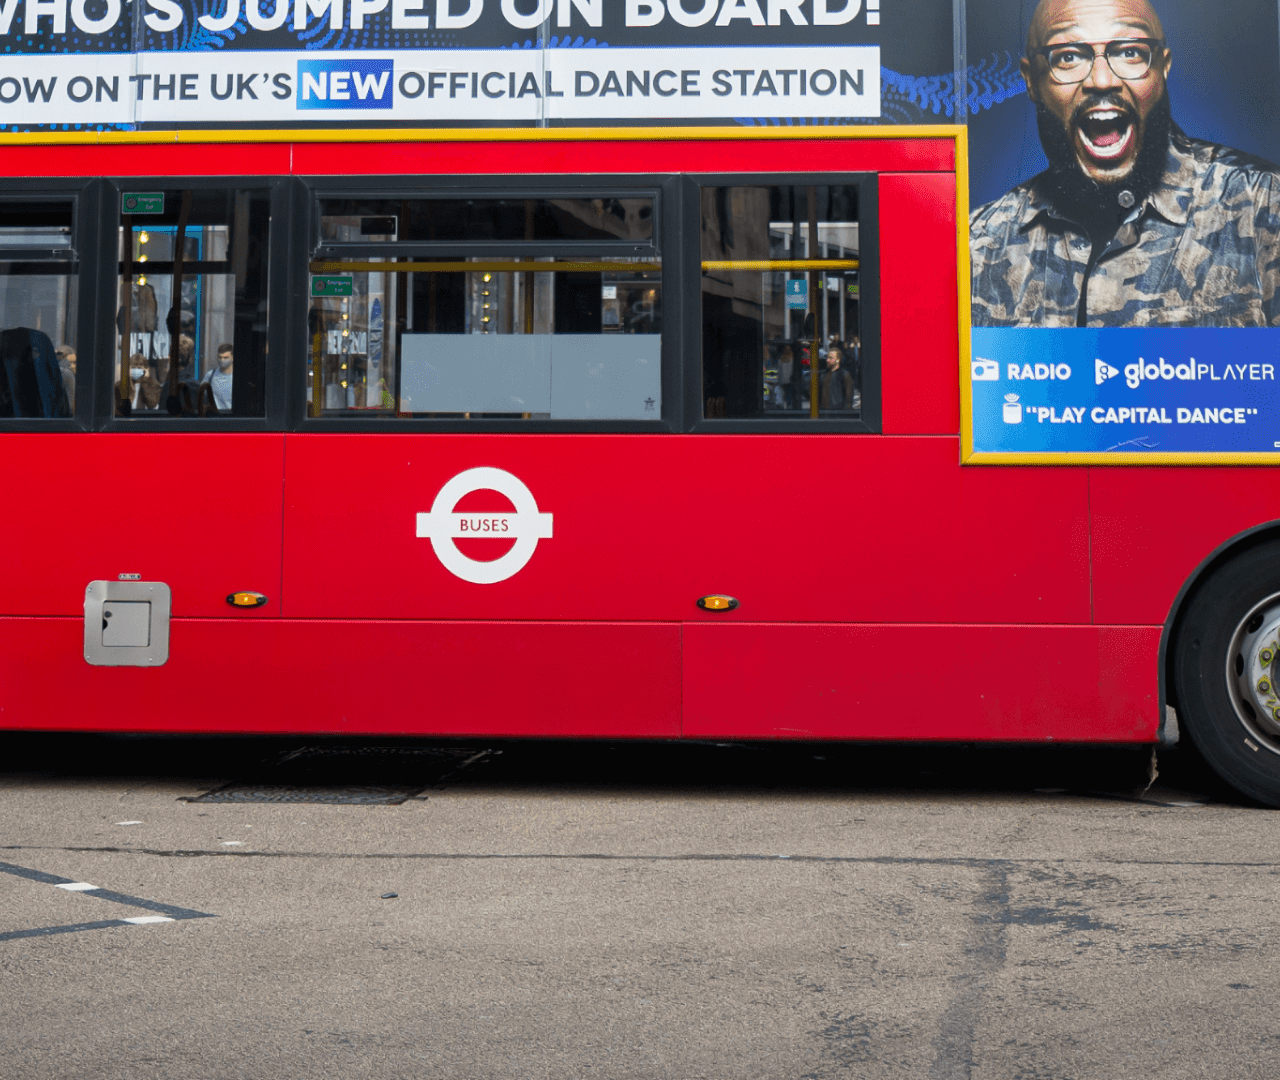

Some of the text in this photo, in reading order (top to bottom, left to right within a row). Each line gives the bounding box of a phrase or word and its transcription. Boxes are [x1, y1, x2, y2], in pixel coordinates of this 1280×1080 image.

[66, 75, 119, 103] ON
[136, 73, 199, 102] THE
[209, 72, 292, 101] UK'S
[301, 71, 389, 101] NEW
[398, 69, 563, 100] OFFICIAL
[574, 69, 701, 98] DANCE
[711, 67, 865, 98] STATION
[1007, 363, 1071, 381] RADIO
[1026, 406, 1258, 424] "PLAY CAPITAL DANCE"
[460, 519, 509, 532] BUSES
